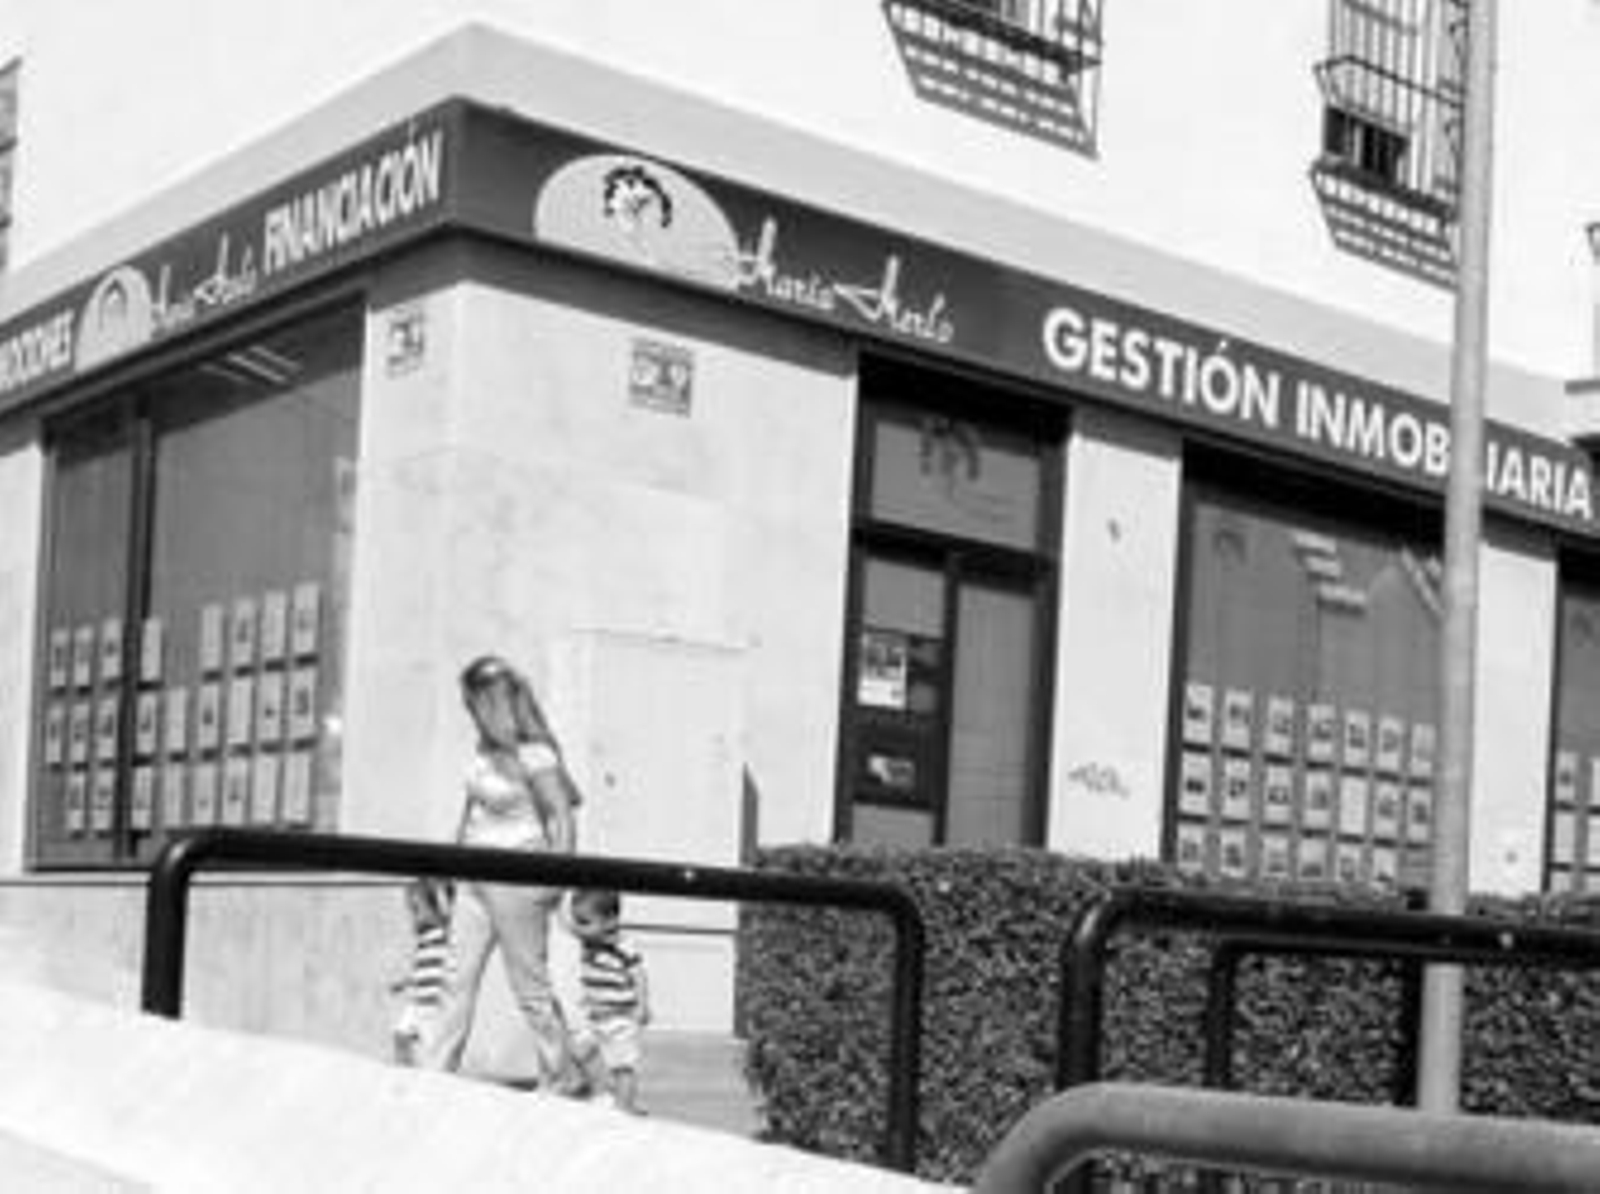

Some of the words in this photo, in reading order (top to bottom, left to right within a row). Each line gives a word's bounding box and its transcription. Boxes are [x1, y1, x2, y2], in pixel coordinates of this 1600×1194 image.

[264, 121, 442, 275] FINANCIACIÓN
[1043, 307, 1280, 427] GESTIÓN
[1296, 380, 1592, 521] INMOBIARIA
